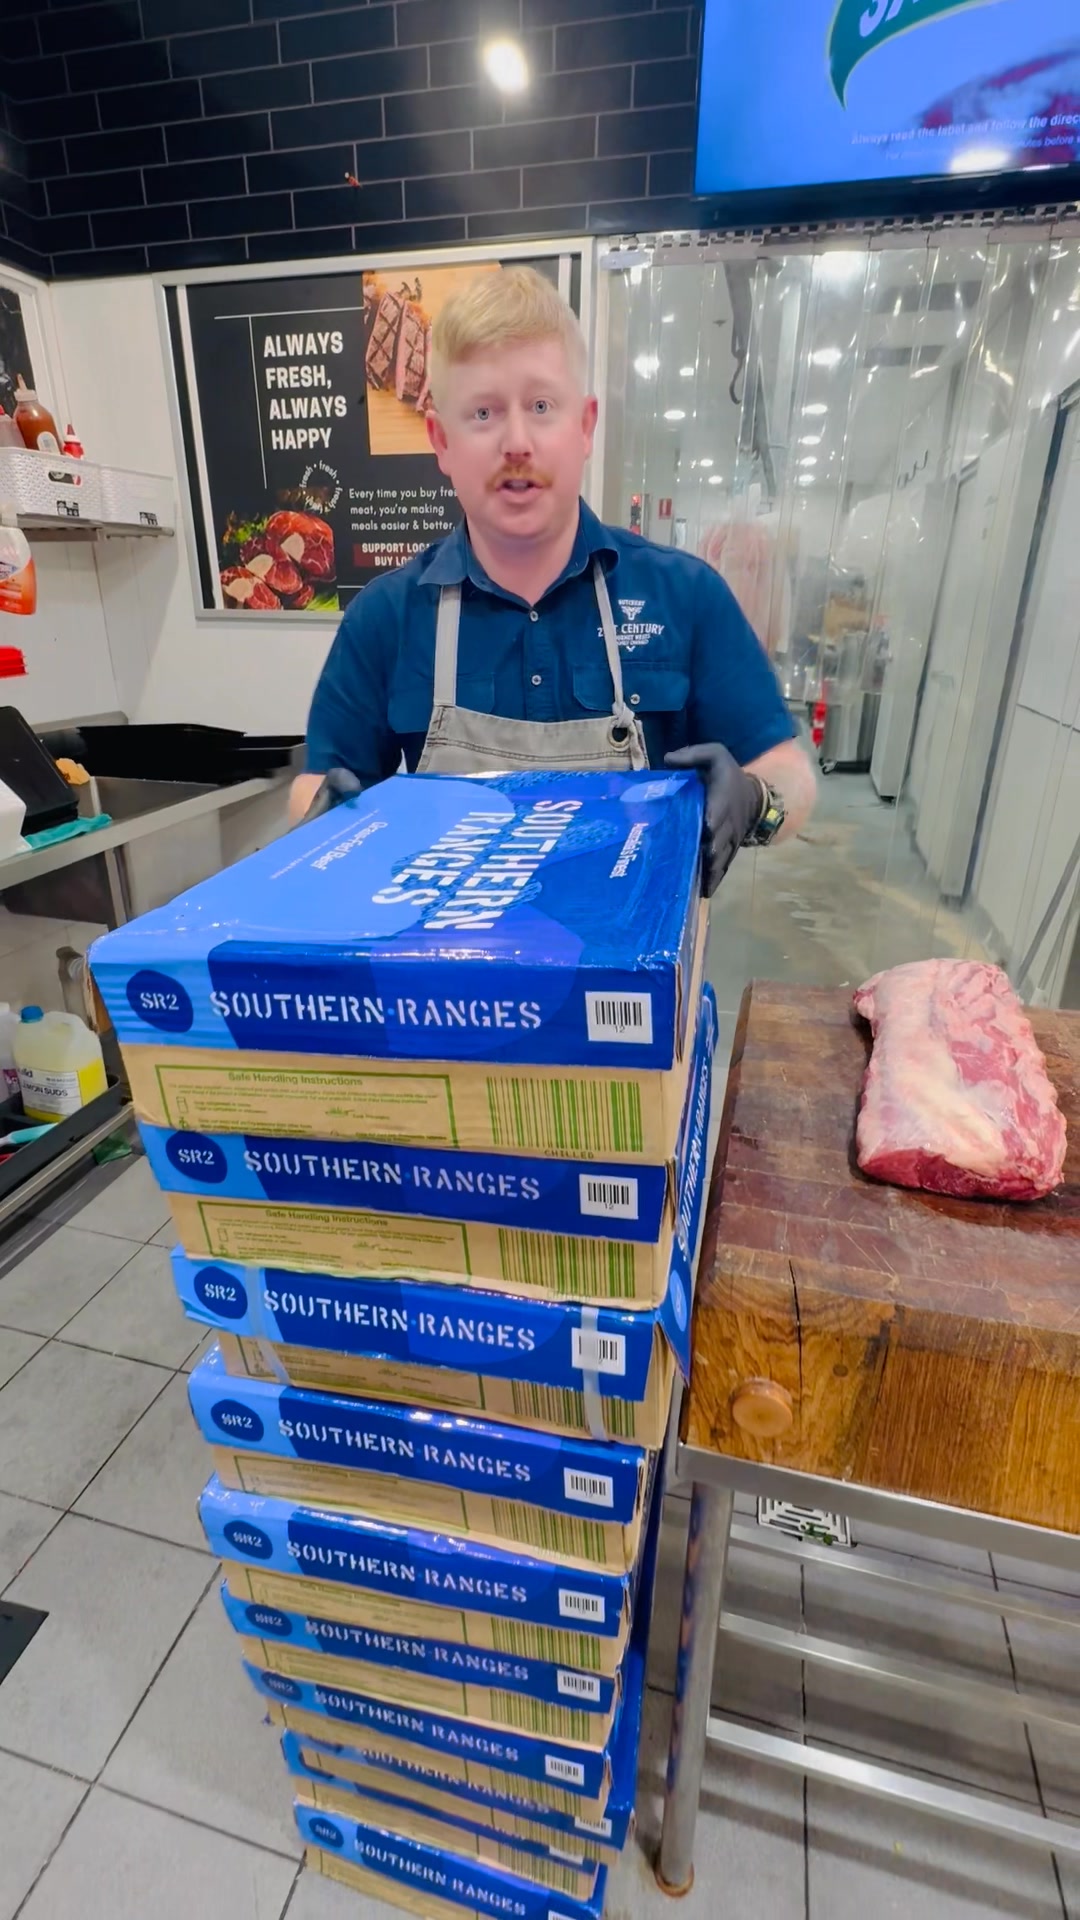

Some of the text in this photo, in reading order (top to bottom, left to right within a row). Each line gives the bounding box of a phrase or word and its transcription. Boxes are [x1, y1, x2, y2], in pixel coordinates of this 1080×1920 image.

[1028, 115, 1048, 128] the
[263, 331, 344, 358] ALWAYS
[265, 364, 332, 390] FRESH,
[269, 395, 348, 420] ALWAYS
[271, 427, 332, 450] HAPPY
[319, 459, 338, 480] fresh
[349, 488, 375, 501] Every
[377, 488, 398, 499] time
[400, 489, 417, 501] you
[420, 487, 437, 500] buy
[350, 503, 445, 517] meat, you're making
[351, 520, 378, 531] meals
[381, 521, 410, 531] easier
[413, 519, 420, 531] &
[362, 542, 404, 553] SUPPORT
[374, 556, 393, 567] BUY
[621, 623, 665, 636] CENTURY
[371, 812, 516, 906] RANGES
[424, 800, 583, 929] SOUTHERN
[140, 992, 179, 1011] SR2
[210, 990, 542, 1029] SOUTHERN RANGES
[614, 1025, 625, 1033] 12
[228, 1072, 363, 1086] Safe Handling Instructions
[178, 1149, 215, 1165] SR2
[544, 1149, 594, 1160] CHILLED
[243, 1149, 540, 1200] SOUTHERN RANGES
[289, 1211, 330, 1224] Handling
[332, 1214, 388, 1227] Instructions
[204, 1283, 237, 1302] SR2
[263, 1289, 535, 1351] SOUTHERN RANGES
[222, 1412, 253, 1429] SR2
[278, 1418, 414, 1458] SOUTHERN
[424, 1444, 531, 1482] RANGES
[286, 1540, 527, 1603] SOUTHERN RANGES
[304, 1620, 529, 1680] SOUTHERN RANGES
[314, 1690, 519, 1762] SOUTHERN RANGES
[354, 1839, 526, 1916] SOUTHERN RANGES
